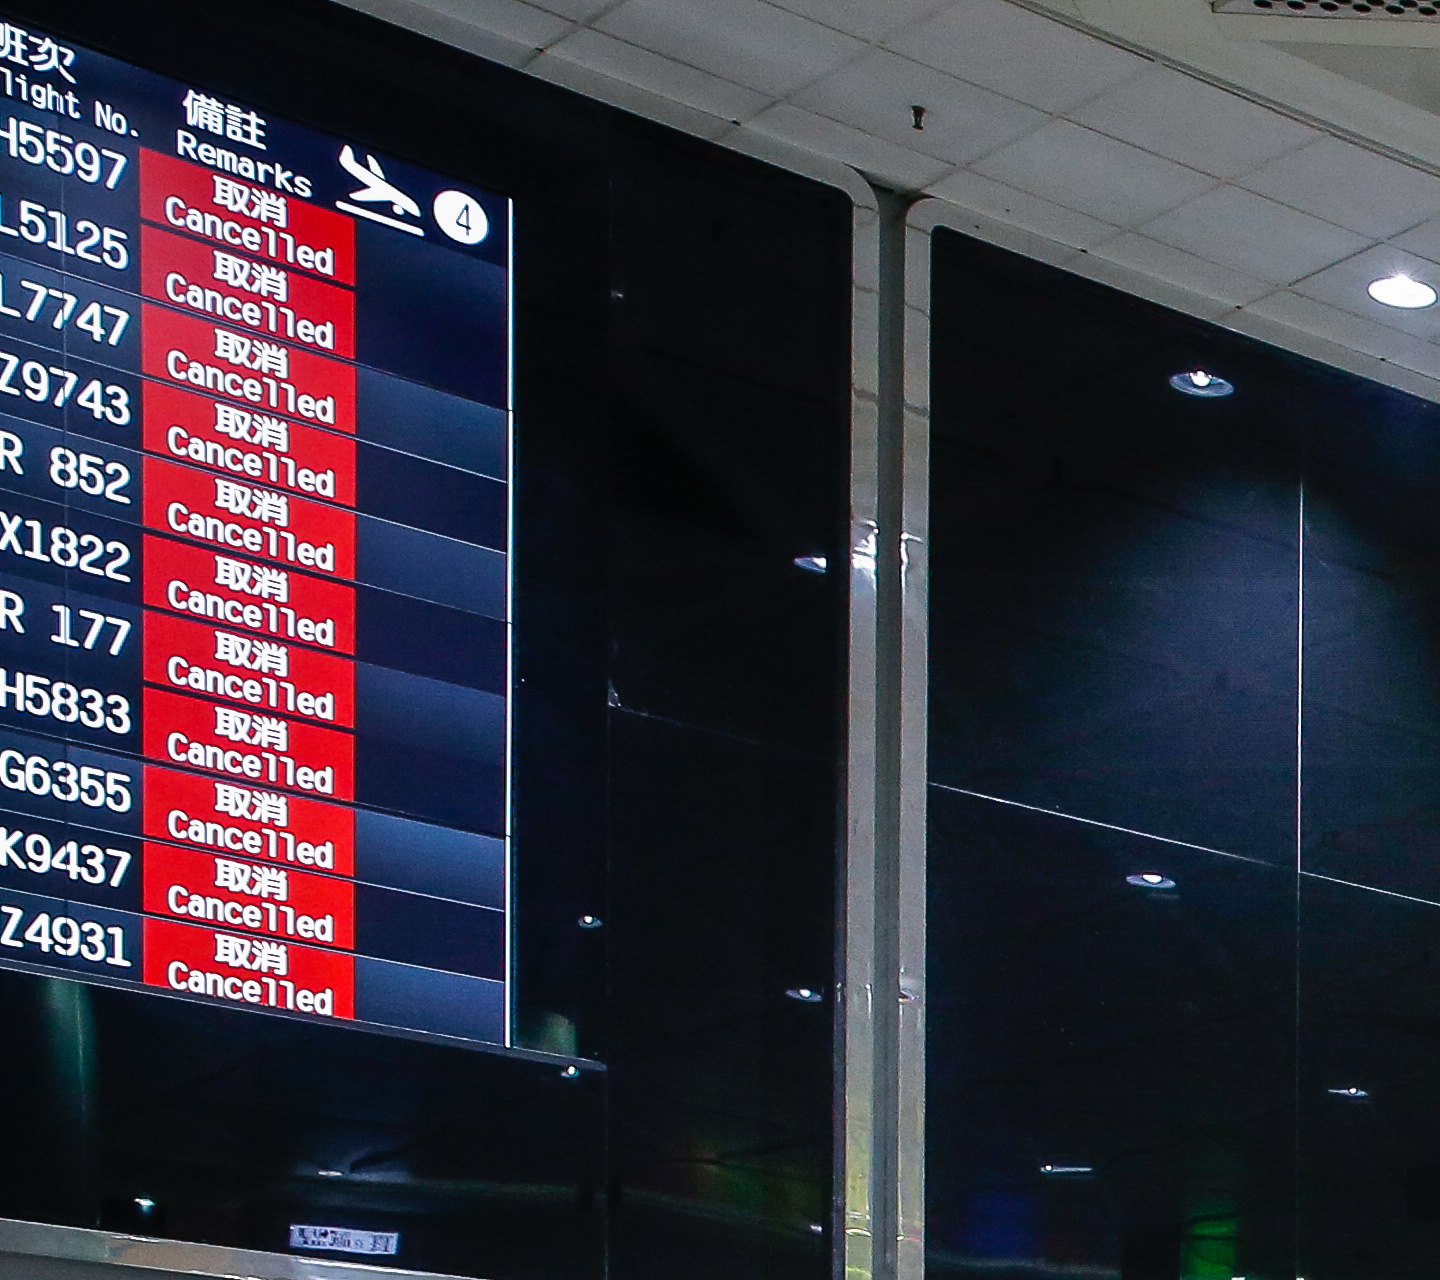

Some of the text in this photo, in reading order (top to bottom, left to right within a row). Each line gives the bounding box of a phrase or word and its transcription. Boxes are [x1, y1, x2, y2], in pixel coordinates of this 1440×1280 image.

[95, 100, 139, 137] No.
[182, 89, 267, 150] 備註
[177, 129, 312, 198] Remarks
[213, 175, 287, 228] 取消
[165, 196, 334, 276] Cancelled
[213, 250, 287, 302] 取消
[166, 273, 334, 350] Cancelled
[214, 328, 288, 379] 取消
[167, 350, 334, 425] Cancelled
[214, 402, 288, 453] 取消
[50, 446, 131, 504] 852
[167, 426, 334, 498] Cancelled
[214, 478, 288, 527] 取消
[168, 502, 334, 572] Cancelled
[214, 555, 288, 603] 取消
[51, 605, 131, 656] 177
[168, 580, 334, 647] Cancelled
[214, 630, 288, 677] 取消
[168, 656, 334, 721] Cancelled
[214, 706, 288, 752] 取消
[167, 732, 333, 795] Cancelled
[214, 782, 288, 827] 取消
[168, 809, 334, 870] Cancelled
[214, 857, 288, 901] 取消
[168, 885, 334, 943] Cancelled
[214, 933, 287, 976] 取消
[168, 961, 335, 1015] Cancelled
